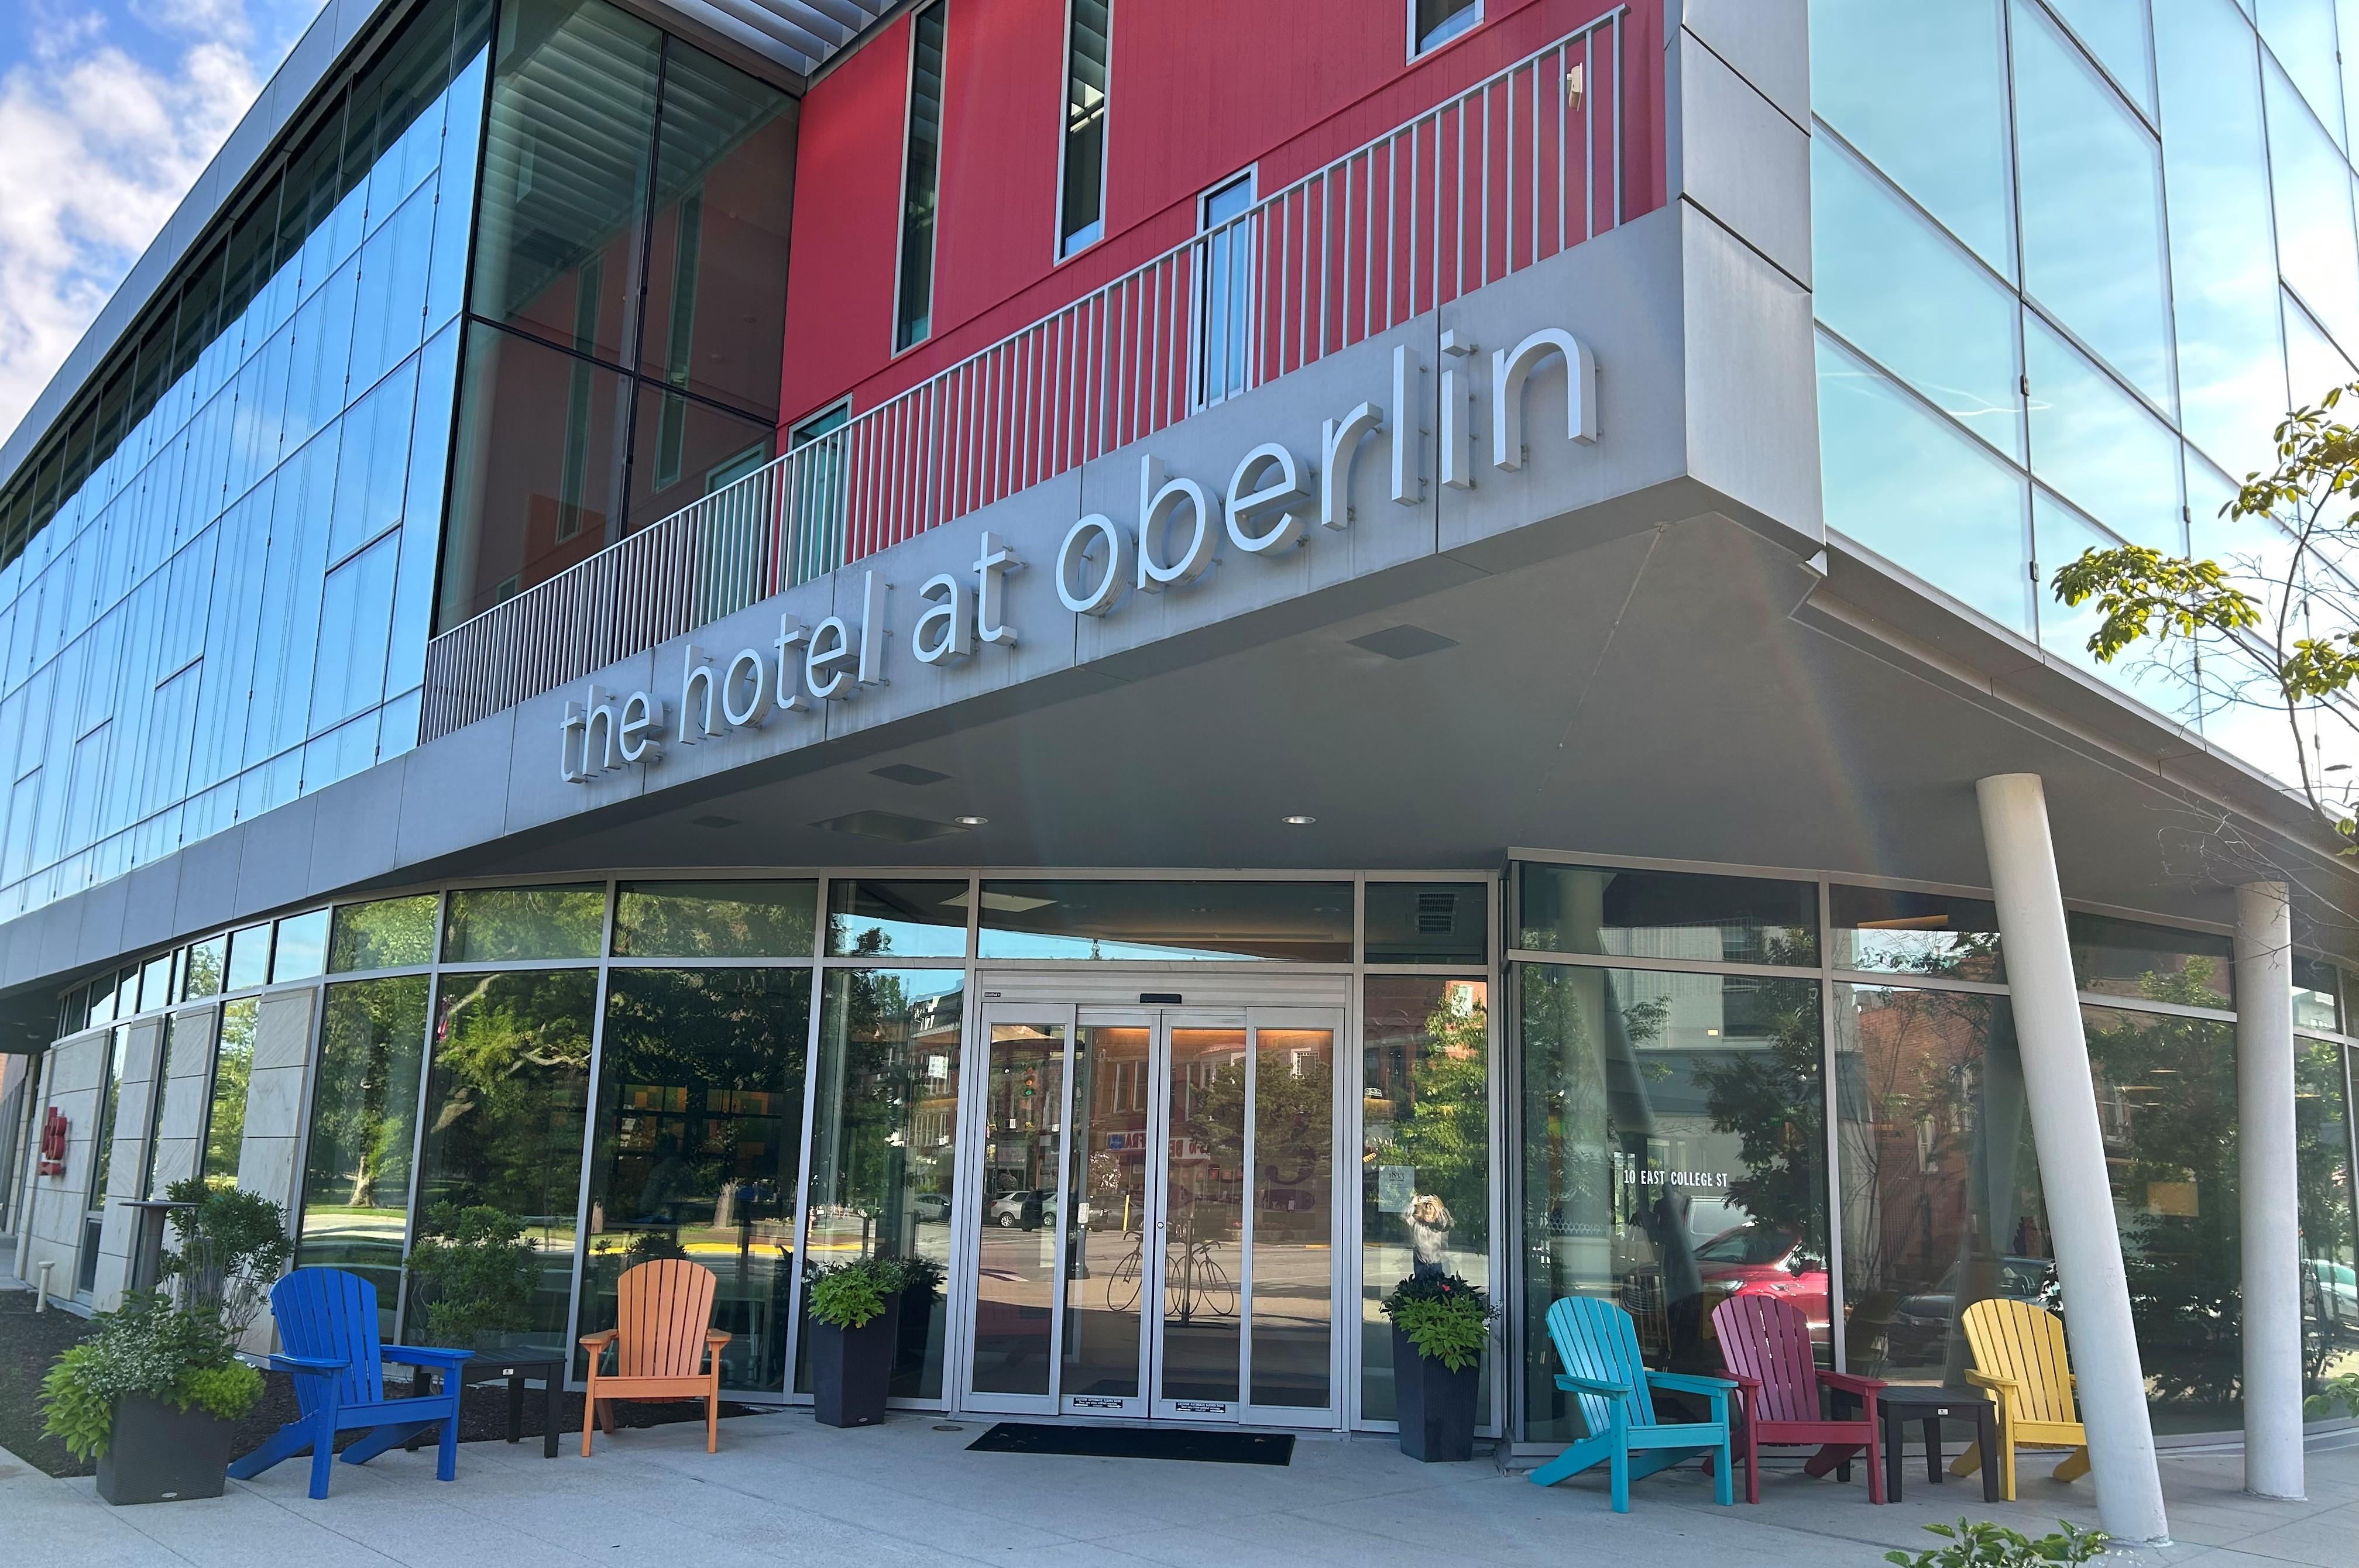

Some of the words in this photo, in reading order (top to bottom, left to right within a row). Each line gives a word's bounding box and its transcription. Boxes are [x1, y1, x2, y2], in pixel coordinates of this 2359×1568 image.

[560, 685, 664, 783] the
[679, 570, 884, 745] hotel
[912, 531, 1021, 666] at
[1055, 328, 1597, 617] oberlin
[1624, 1169, 1636, 1184] 10
[1641, 1170, 1666, 1185] EAST
[1671, 1171, 1712, 1187] COLLEGE
[1716, 1172, 1728, 1187] ST
